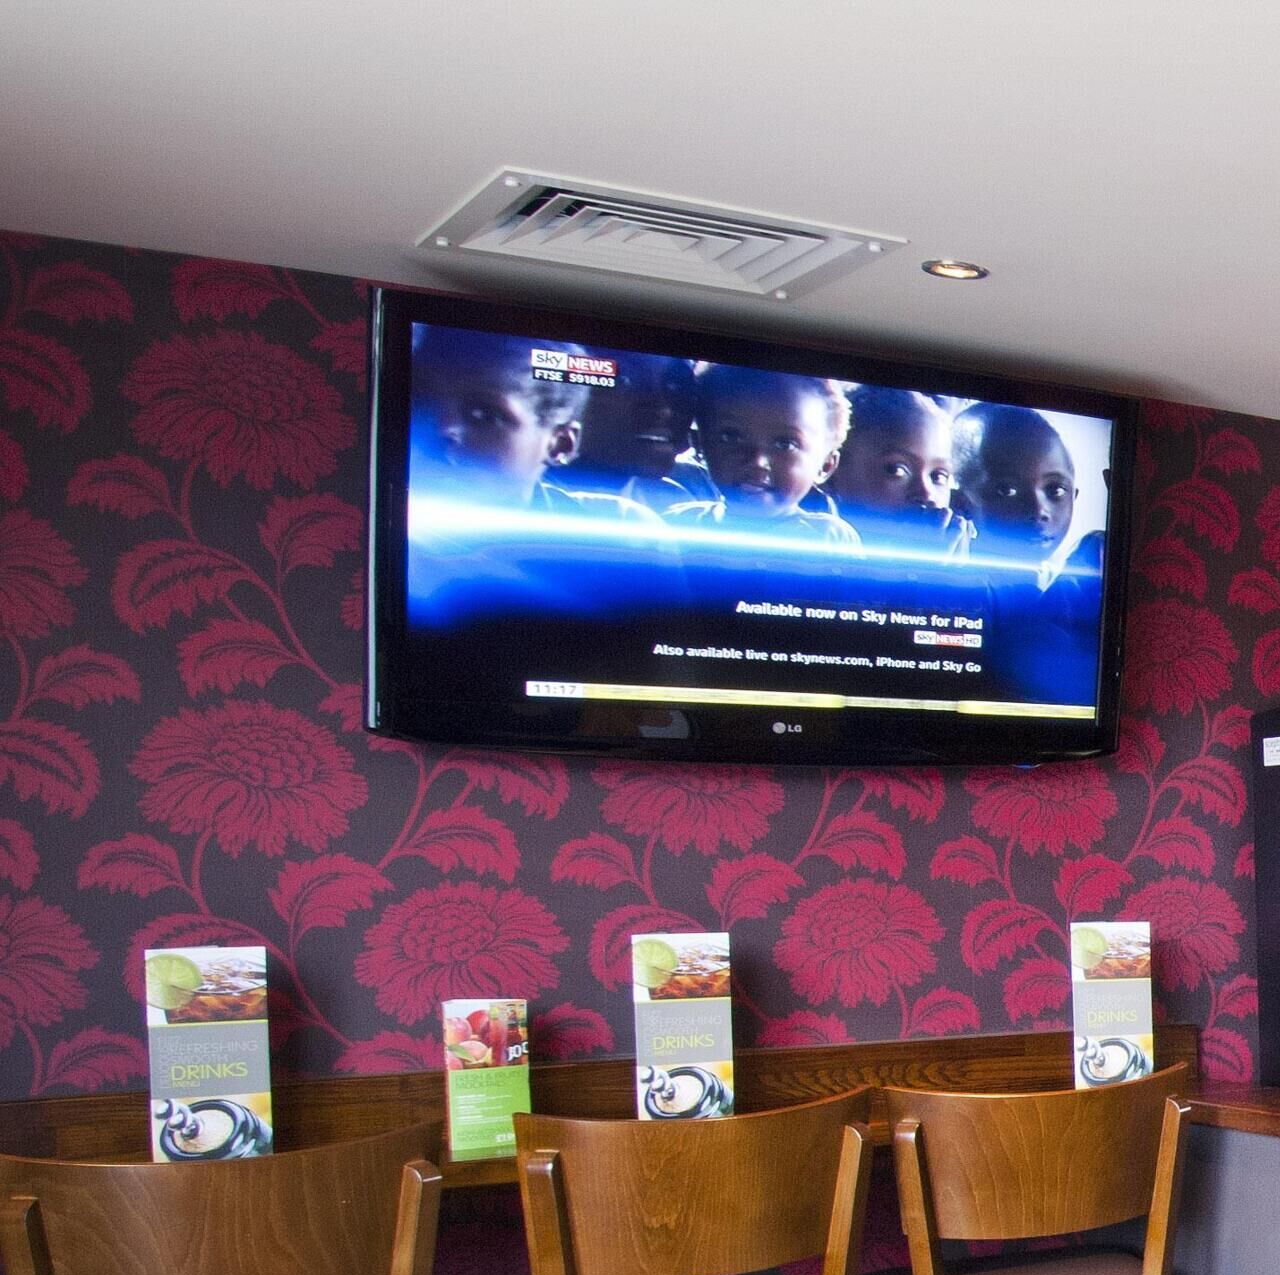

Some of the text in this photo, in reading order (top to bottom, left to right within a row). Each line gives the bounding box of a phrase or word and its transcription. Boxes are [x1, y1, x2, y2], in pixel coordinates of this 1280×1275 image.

[536, 352, 614, 374] sky NEWS
[534, 368, 564, 382] FTSE
[735, 600, 983, 630] Available now on Sky News for iPad
[936, 634, 964, 646] NEWS
[652, 643, 982, 674] Also available live on skynews.com, iPhone and Sky Go
[787, 724, 802, 734] LG
[1086, 1009, 1138, 1023] DRINKS
[651, 1033, 714, 1051] DRINKS
[170, 1061, 249, 1081] DRINKS
